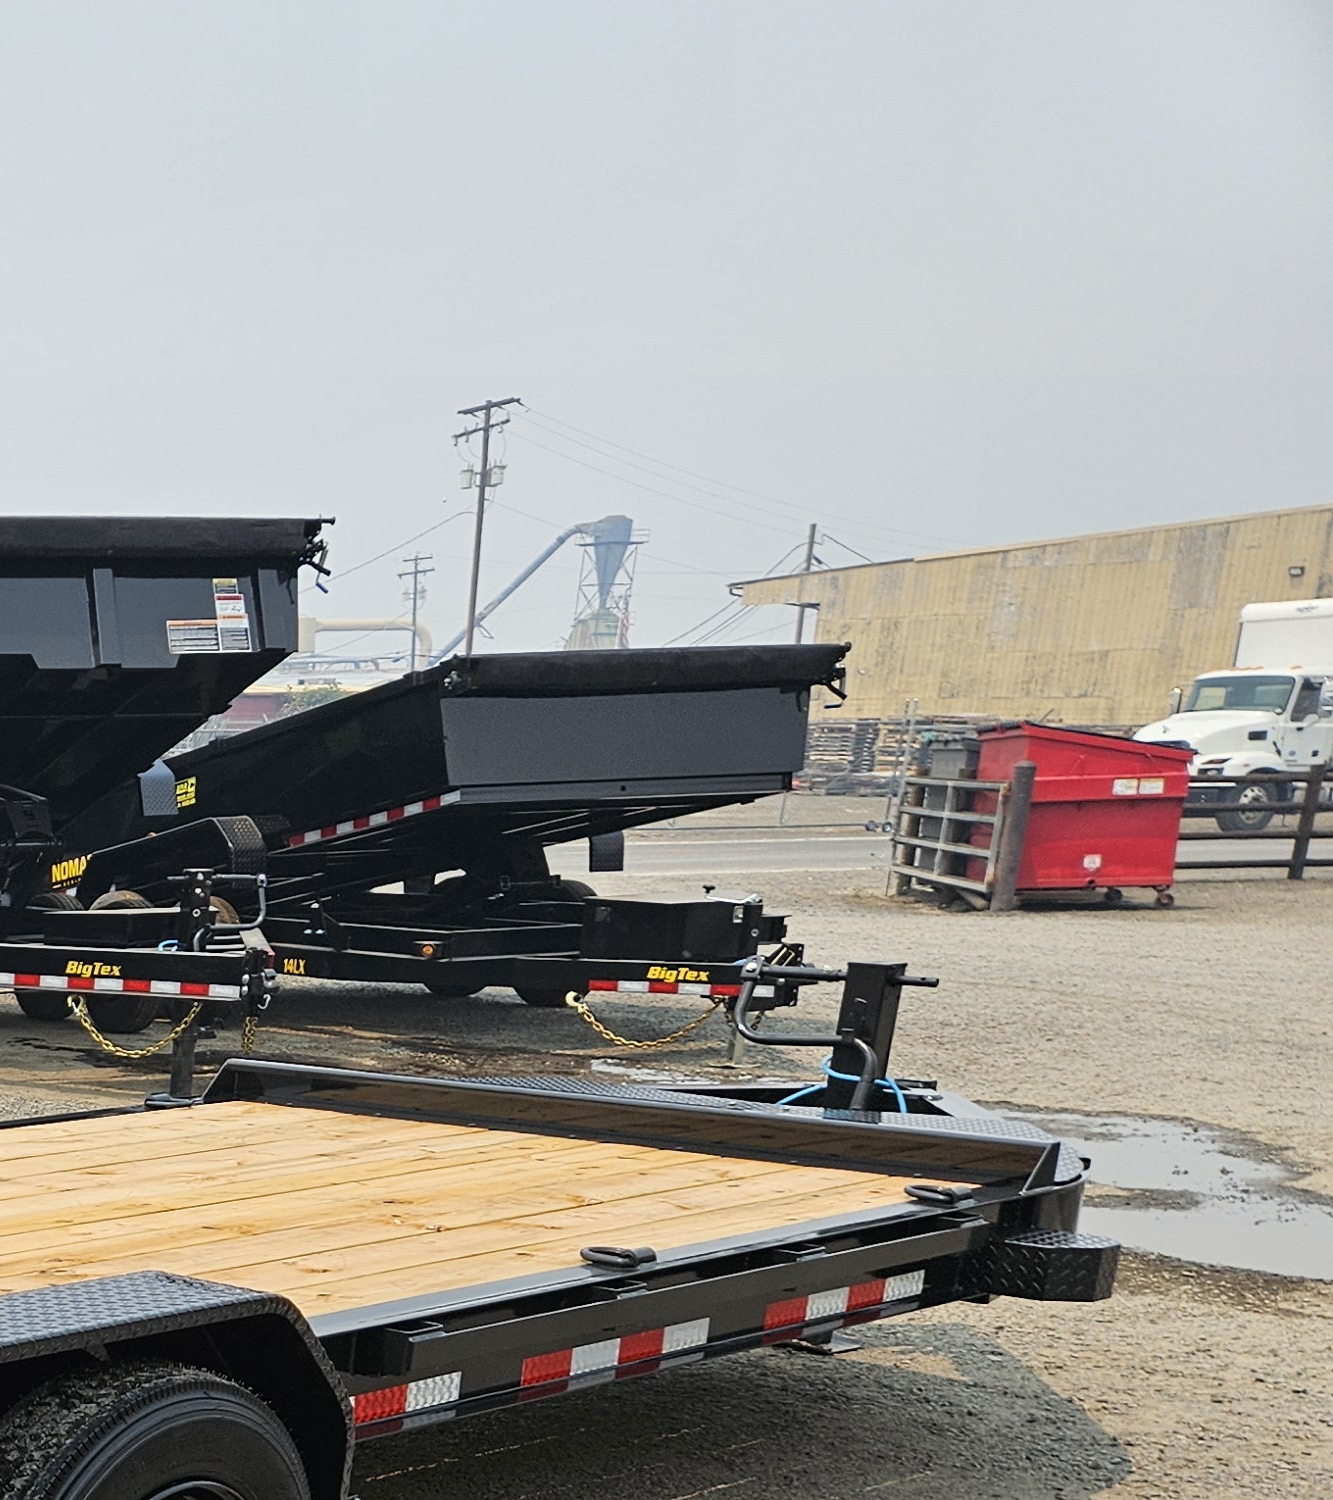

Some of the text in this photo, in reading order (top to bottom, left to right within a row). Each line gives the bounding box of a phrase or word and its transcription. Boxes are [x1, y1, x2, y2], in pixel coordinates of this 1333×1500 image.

[65, 960, 121, 977] BigTex
[283, 958, 306, 975] 14LX
[646, 966, 710, 983] BigTex
